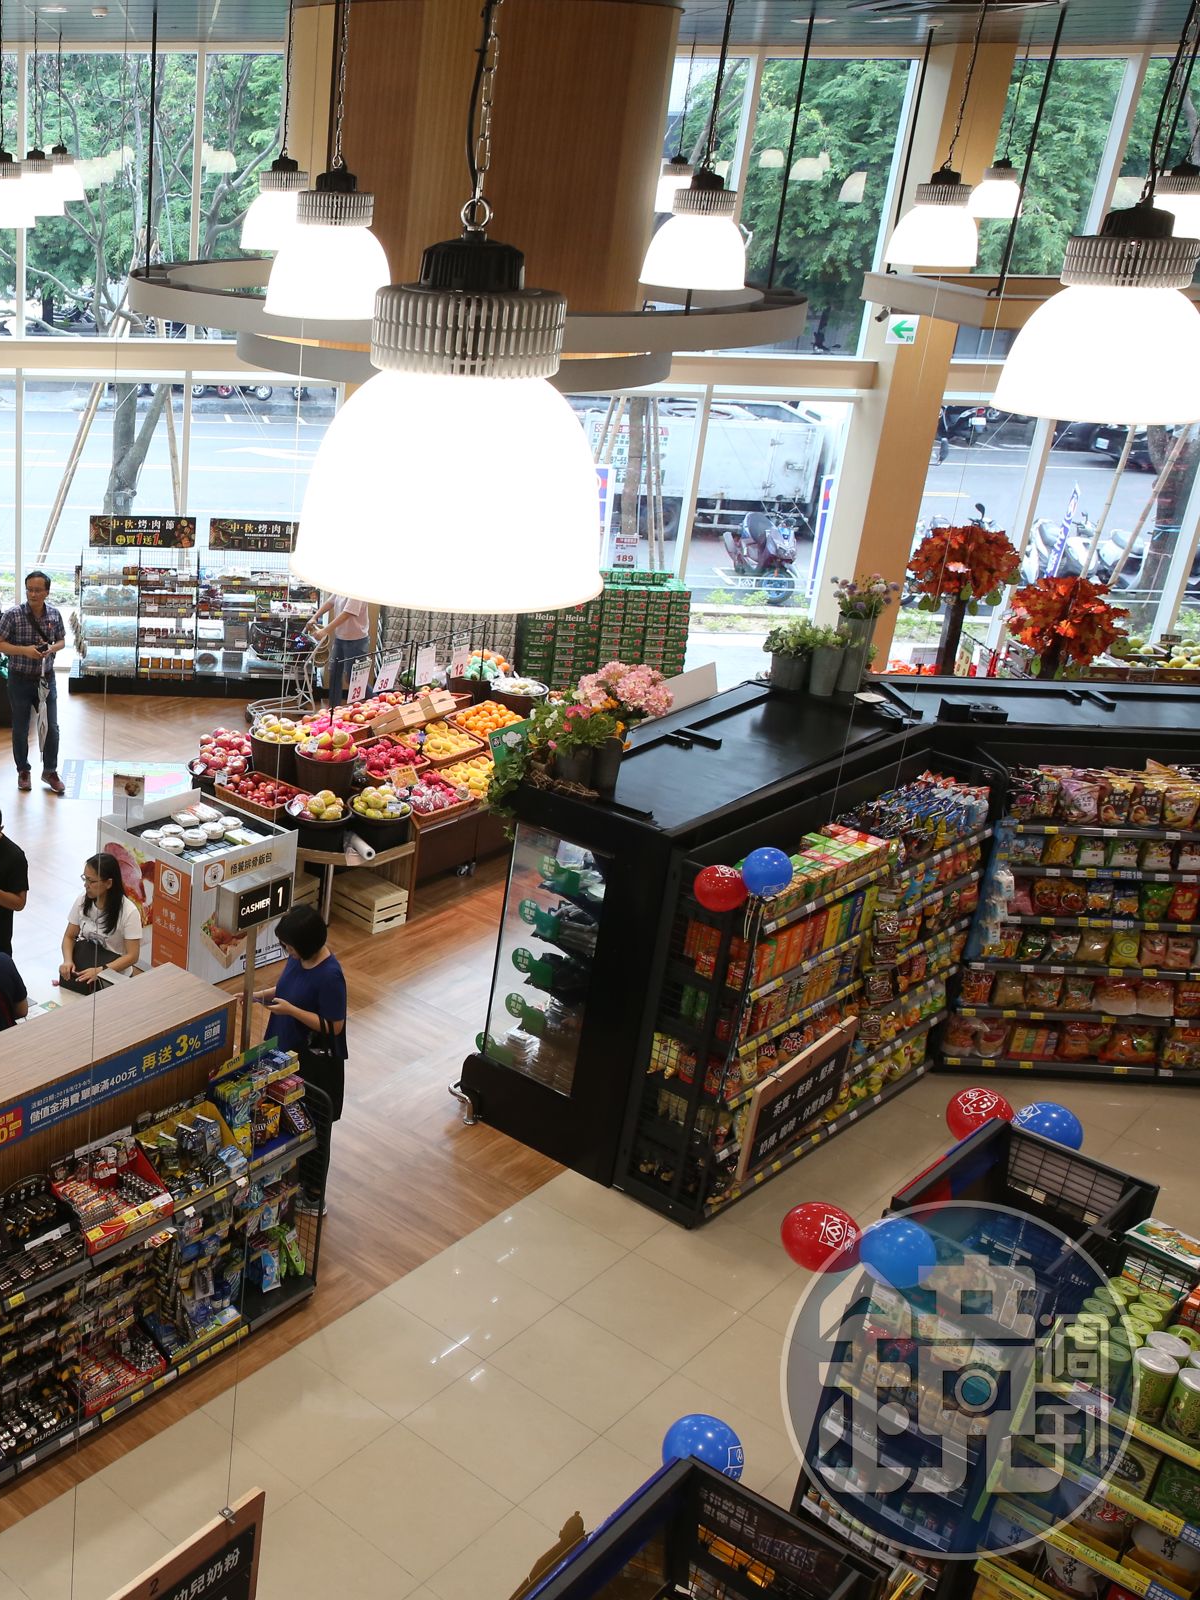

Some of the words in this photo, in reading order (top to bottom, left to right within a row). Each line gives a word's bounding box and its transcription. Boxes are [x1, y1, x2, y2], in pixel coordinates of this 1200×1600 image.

[240, 897, 271, 916] CASHIER
[277, 886, 283, 907] 1
[33, 1417, 74, 1445] DURACELL
